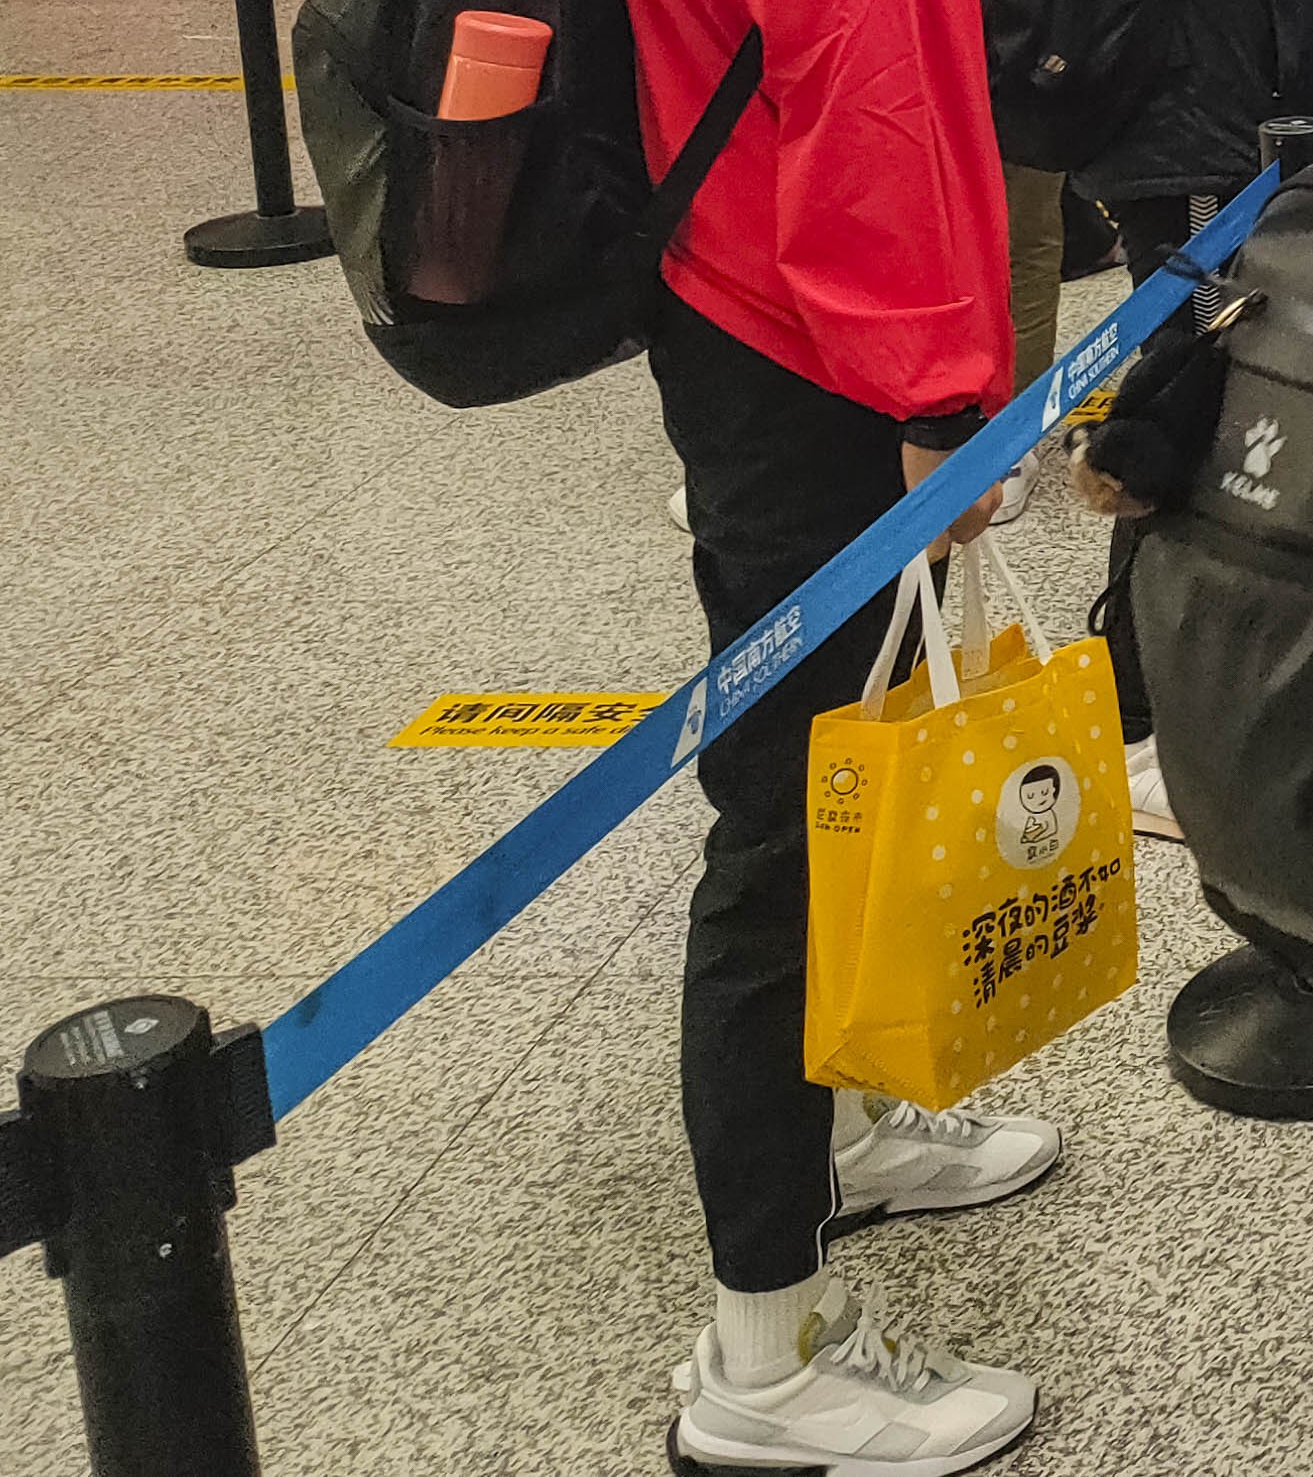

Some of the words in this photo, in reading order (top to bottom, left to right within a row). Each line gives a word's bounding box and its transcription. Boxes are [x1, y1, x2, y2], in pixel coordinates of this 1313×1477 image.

[716, 604, 803, 695] 中国南方航空
[418, 725, 488, 737] Please
[489, 724, 538, 737] keep
[563, 725, 608, 735] safe
[962, 857, 1122, 967] 深夜的酒不如
